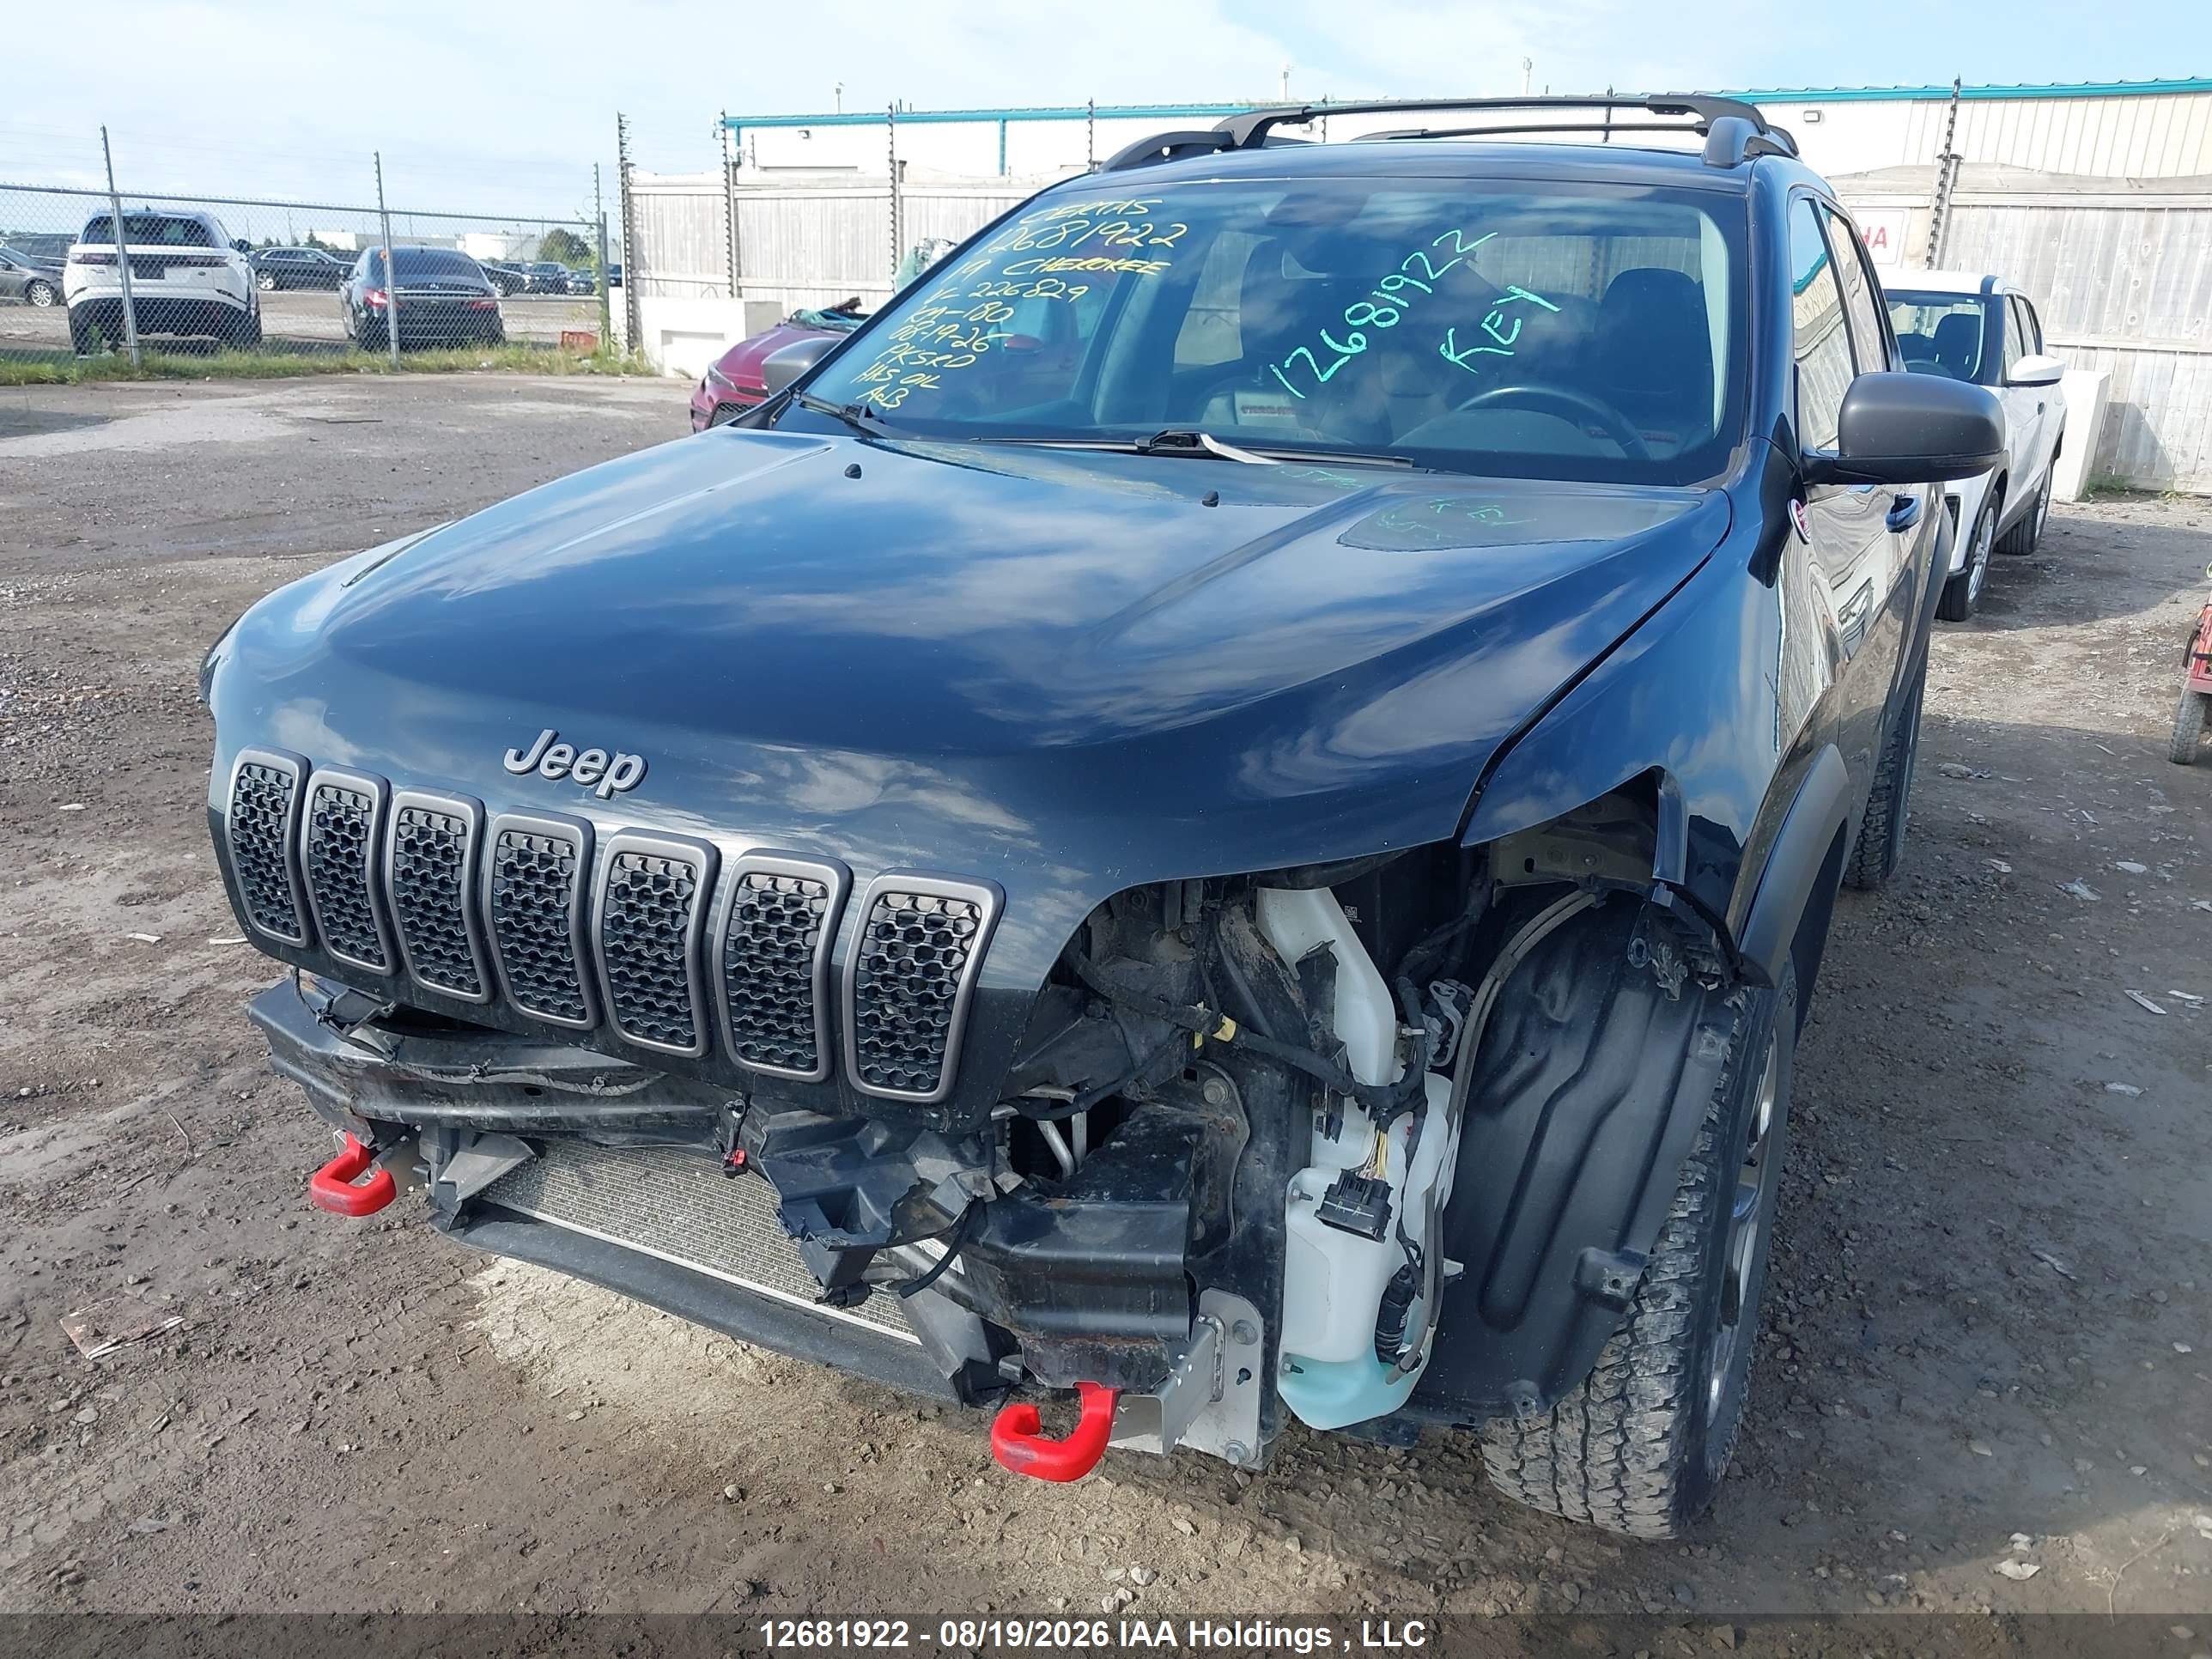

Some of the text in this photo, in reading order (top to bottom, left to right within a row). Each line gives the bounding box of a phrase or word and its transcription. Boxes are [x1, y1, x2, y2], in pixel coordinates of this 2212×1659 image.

[975, 220, 1188, 255] 12681922
[1003, 257, 1171, 276] CHEROKEE
[969, 278, 1089, 303] 226829
[1269, 229, 1498, 398] 12681922
[1439, 285, 1561, 374] KEY
[888, 320, 1014, 352] 08-19-26
[900, 373, 941, 389] OIL
[503, 728, 648, 799] Jeep
